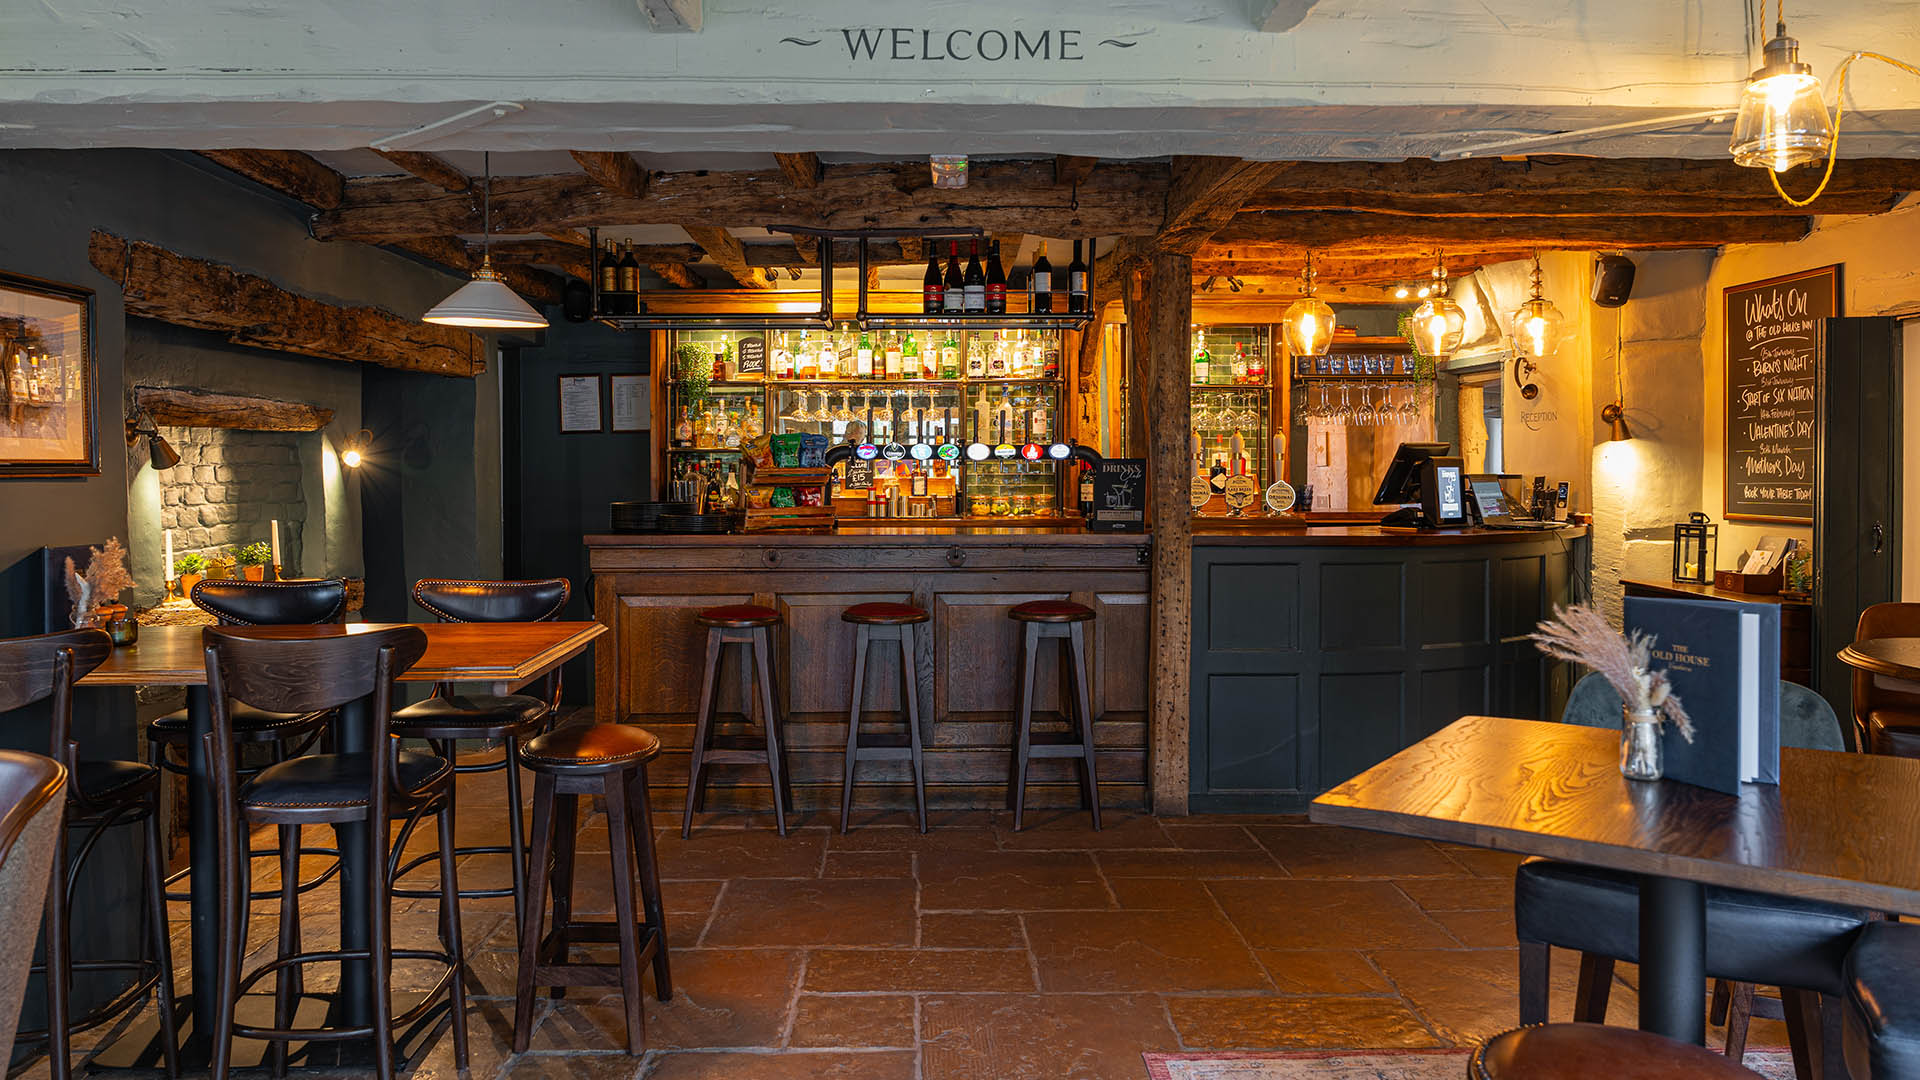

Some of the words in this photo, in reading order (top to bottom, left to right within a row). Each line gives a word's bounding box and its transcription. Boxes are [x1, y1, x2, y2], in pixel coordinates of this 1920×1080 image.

[841, 28, 1084, 61] WELCOME
[1745, 289, 1784, 326] What's
[1787, 288, 1808, 317] On
[1745, 329, 1753, 342] @
[1754, 325, 1767, 341] THE
[1768, 324, 1781, 336] OLD
[1782, 321, 1801, 334] HOUSE
[1802, 320, 1813, 330] INN
[1783, 354, 1809, 372] NIGHT
[1741, 388, 1763, 412] START
[1773, 387, 1786, 405] SIX
[1796, 419, 1814, 439] DAY
[852, 473, 866, 482] £15
[1102, 463, 1141, 473] DRINKS
[1785, 455, 1806, 480] Day
[1651, 650, 1673, 660] OLD
[1675, 653, 1711, 667] HOUSE
